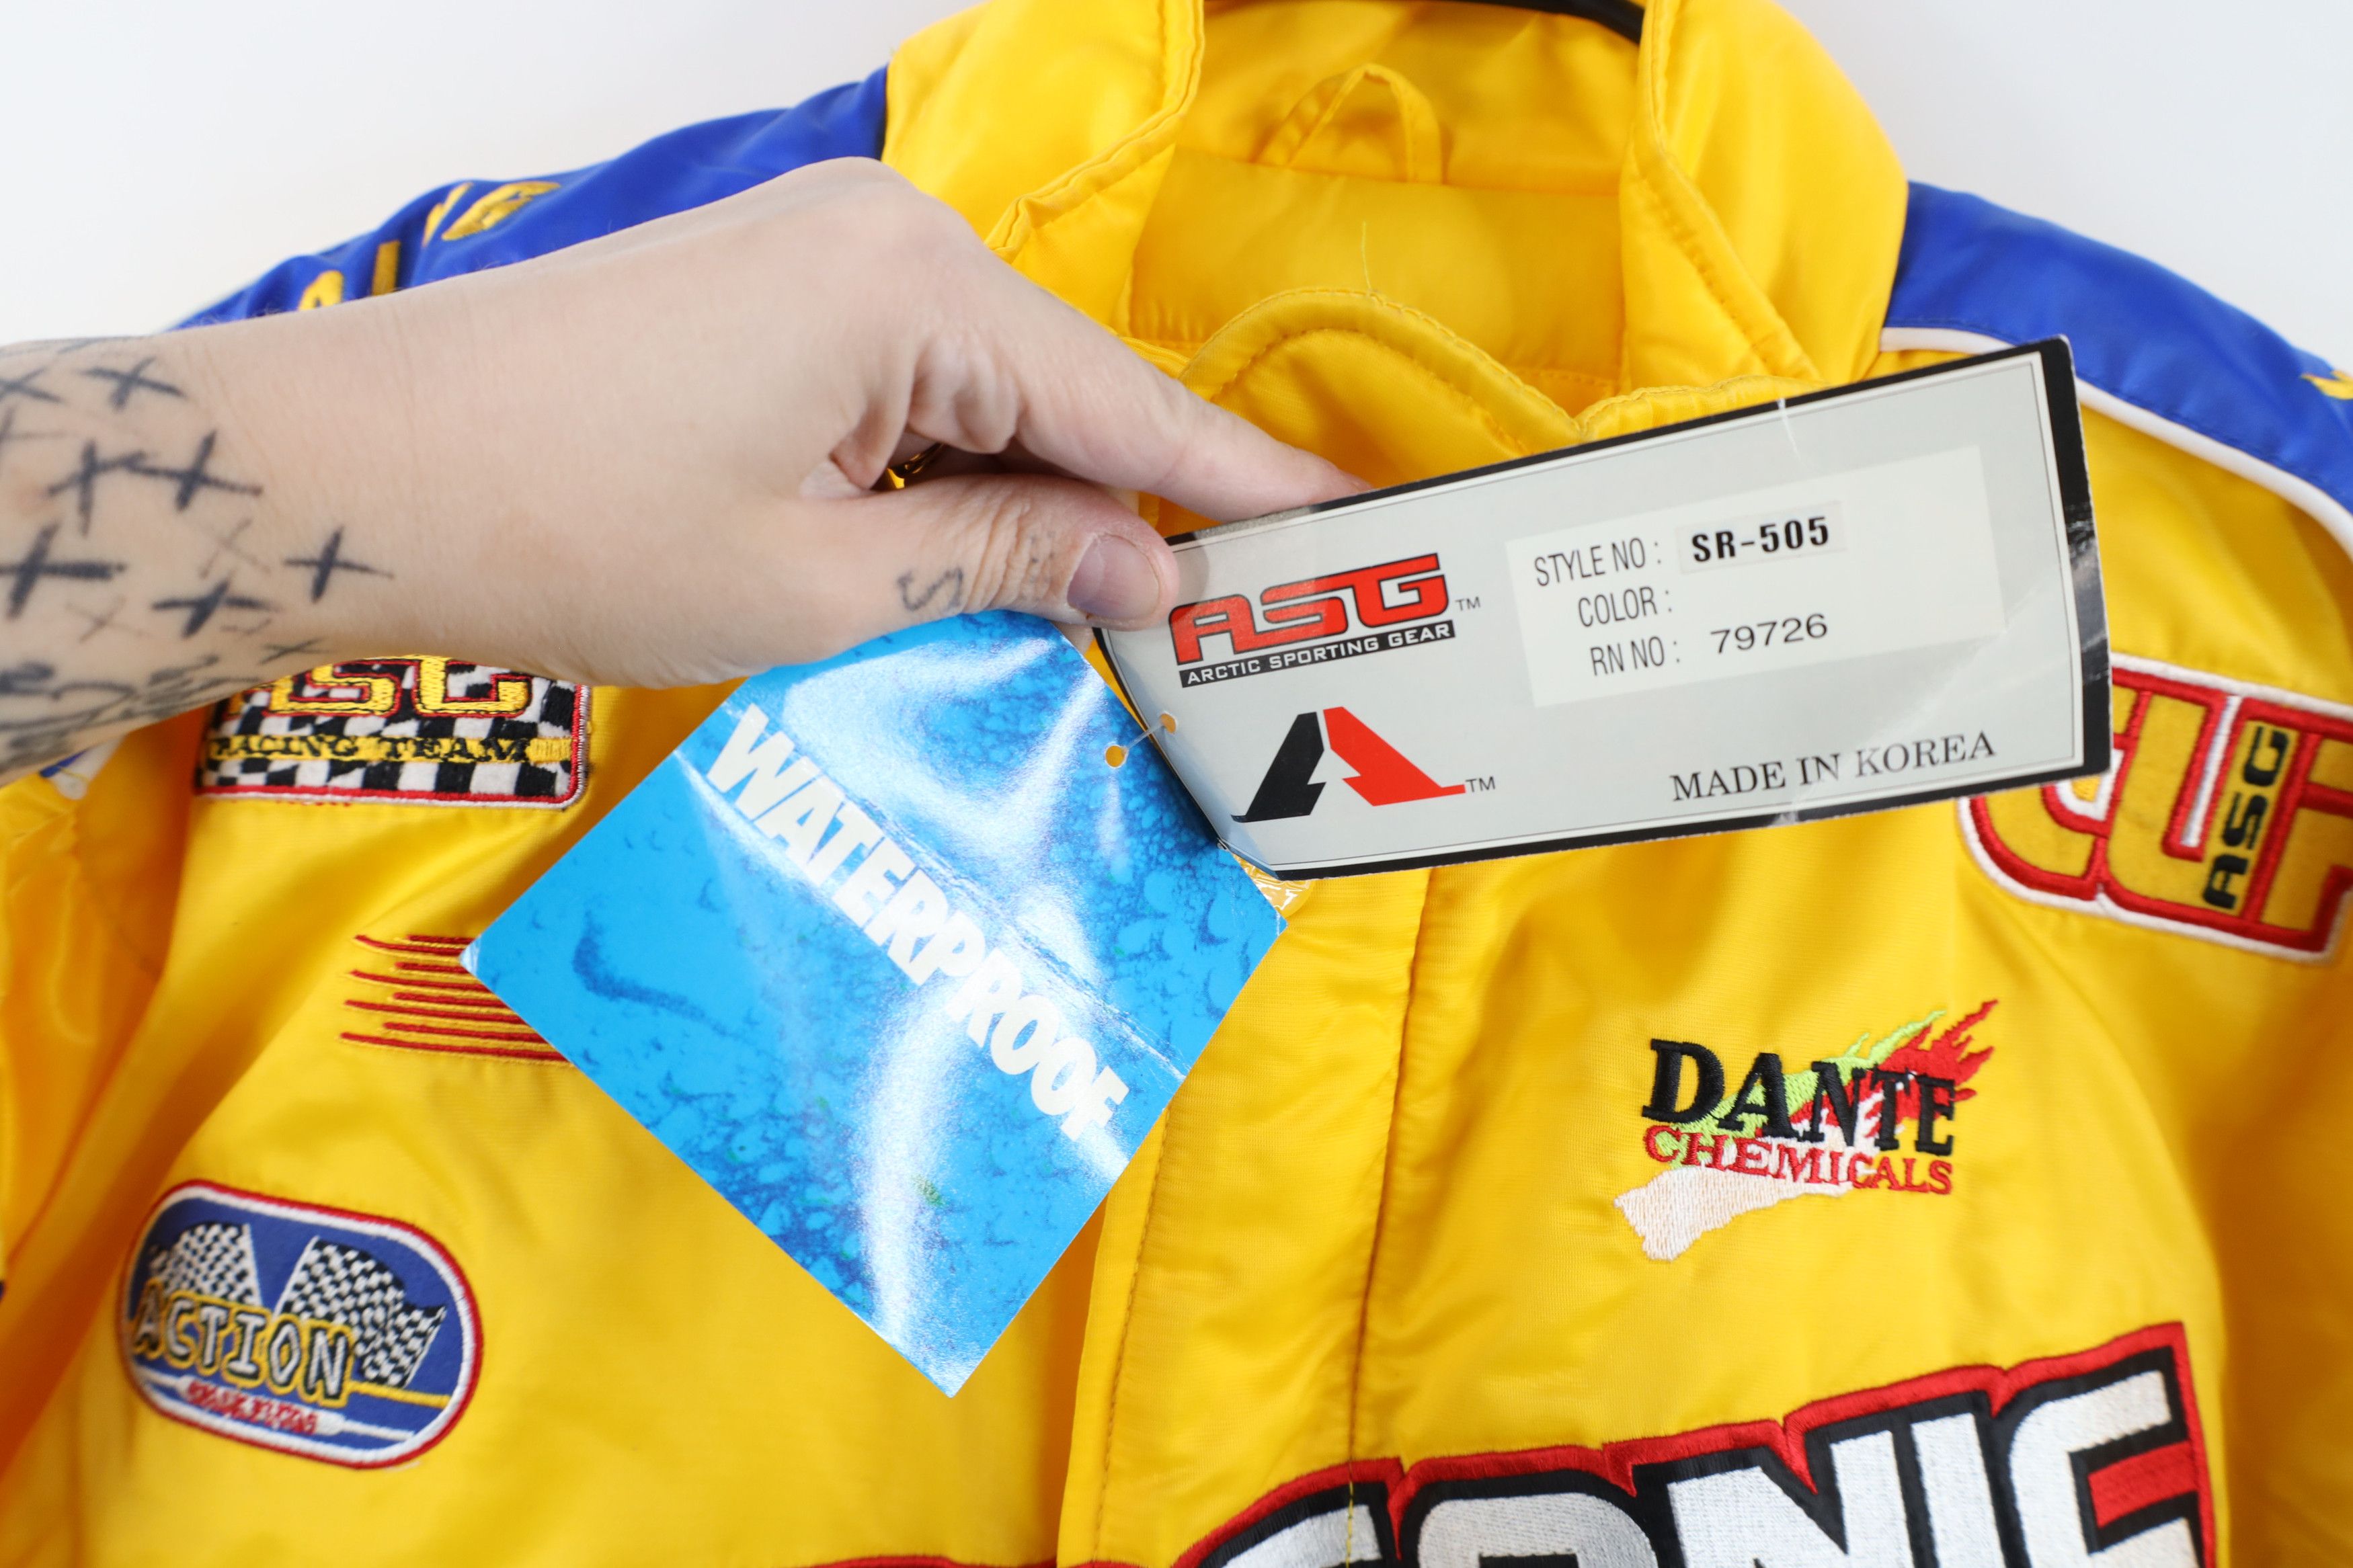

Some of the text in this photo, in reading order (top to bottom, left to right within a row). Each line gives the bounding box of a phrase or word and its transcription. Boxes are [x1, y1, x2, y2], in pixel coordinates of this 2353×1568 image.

[1535, 545, 1605, 587] STYLE
[1691, 515, 1830, 563] SR-505
[1168, 552, 1449, 665] ASG
[1455, 596, 1481, 612] TM
[1710, 613, 1828, 655] 79726
[1187, 624, 1451, 686] ARCTIC SPORTING GEAR
[1590, 643, 1624, 677] RN
[380, 737, 530, 763] TEAM
[1670, 731, 1997, 802] MADE IN KOREA
[1465, 776, 1496, 793] TM
[2202, 726, 2289, 910] ASG
[706, 703, 1129, 1143] WATERPROOF
[1641, 1039, 1955, 1157] DANTE
[1642, 1124, 1953, 1195] CHEMICALS
[135, 1282, 352, 1403] ACTION
